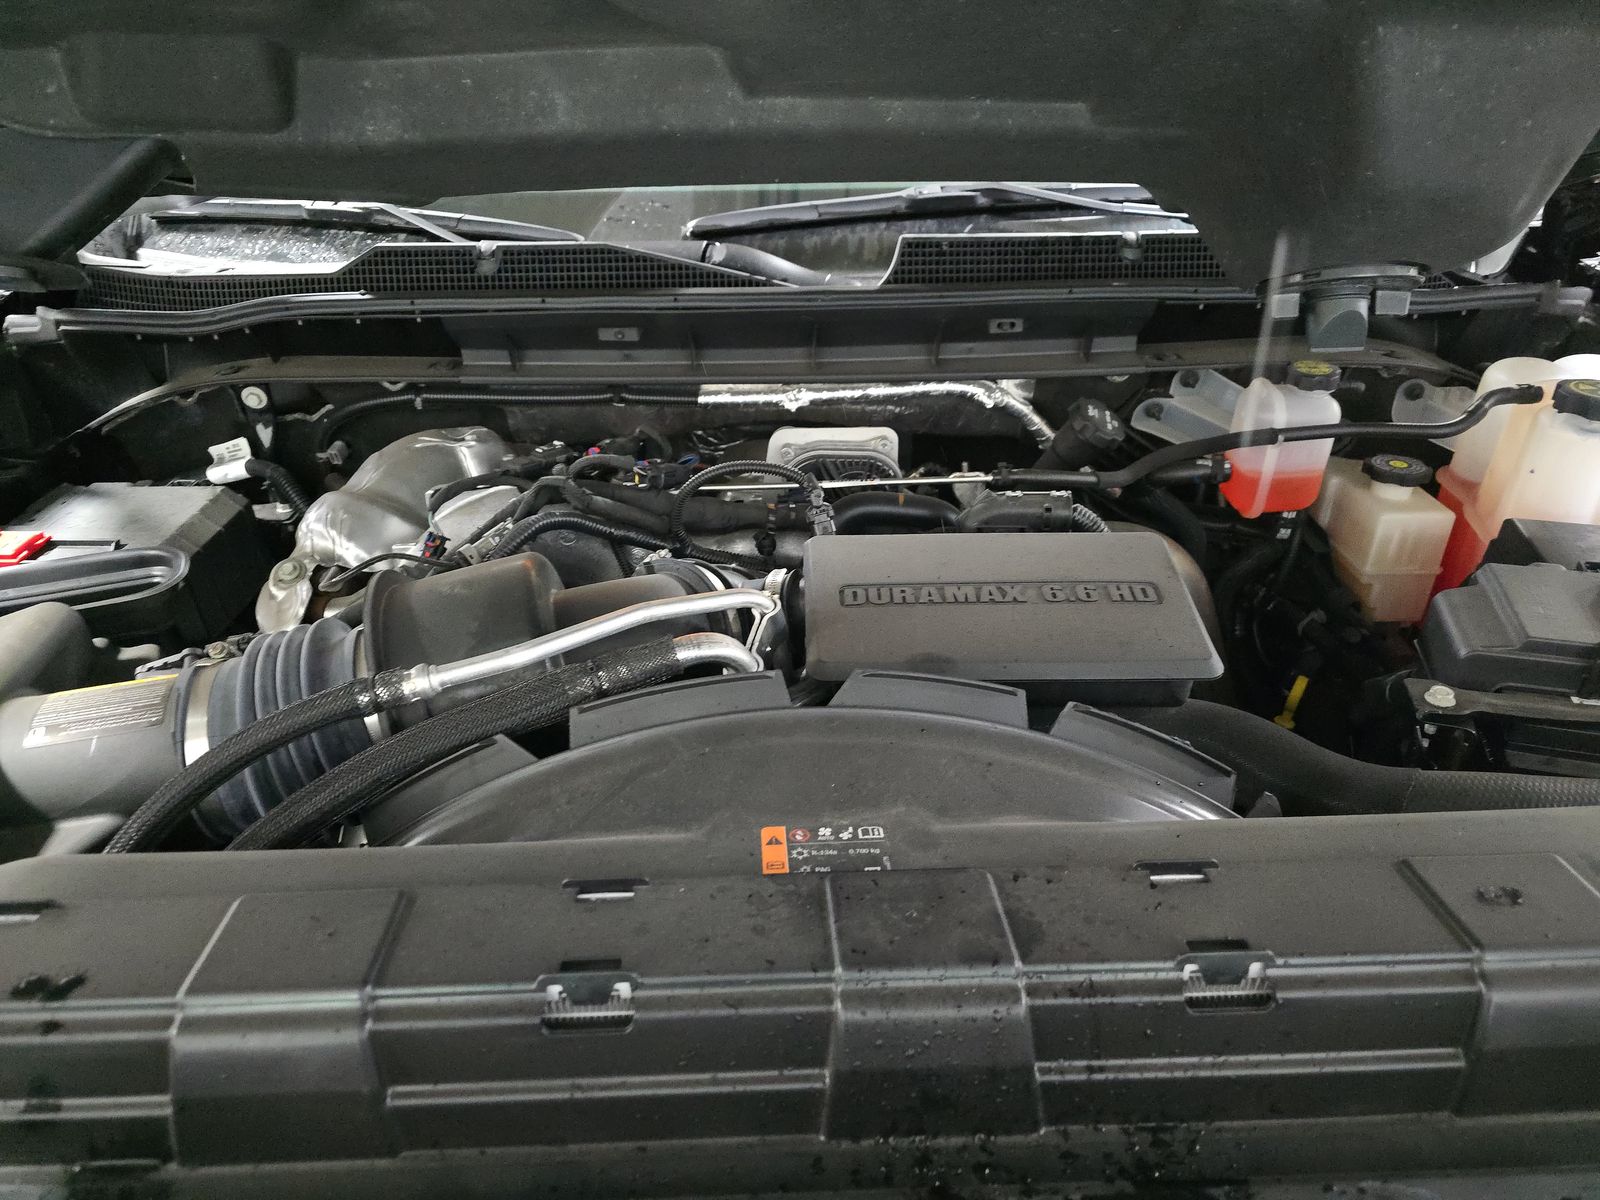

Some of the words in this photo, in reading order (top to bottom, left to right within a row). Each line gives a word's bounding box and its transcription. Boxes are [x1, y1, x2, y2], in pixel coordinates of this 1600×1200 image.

[842, 584, 1028, 606] DURAMAX
[1041, 584, 1101, 603] 6.6
[1107, 583, 1160, 603] HD
